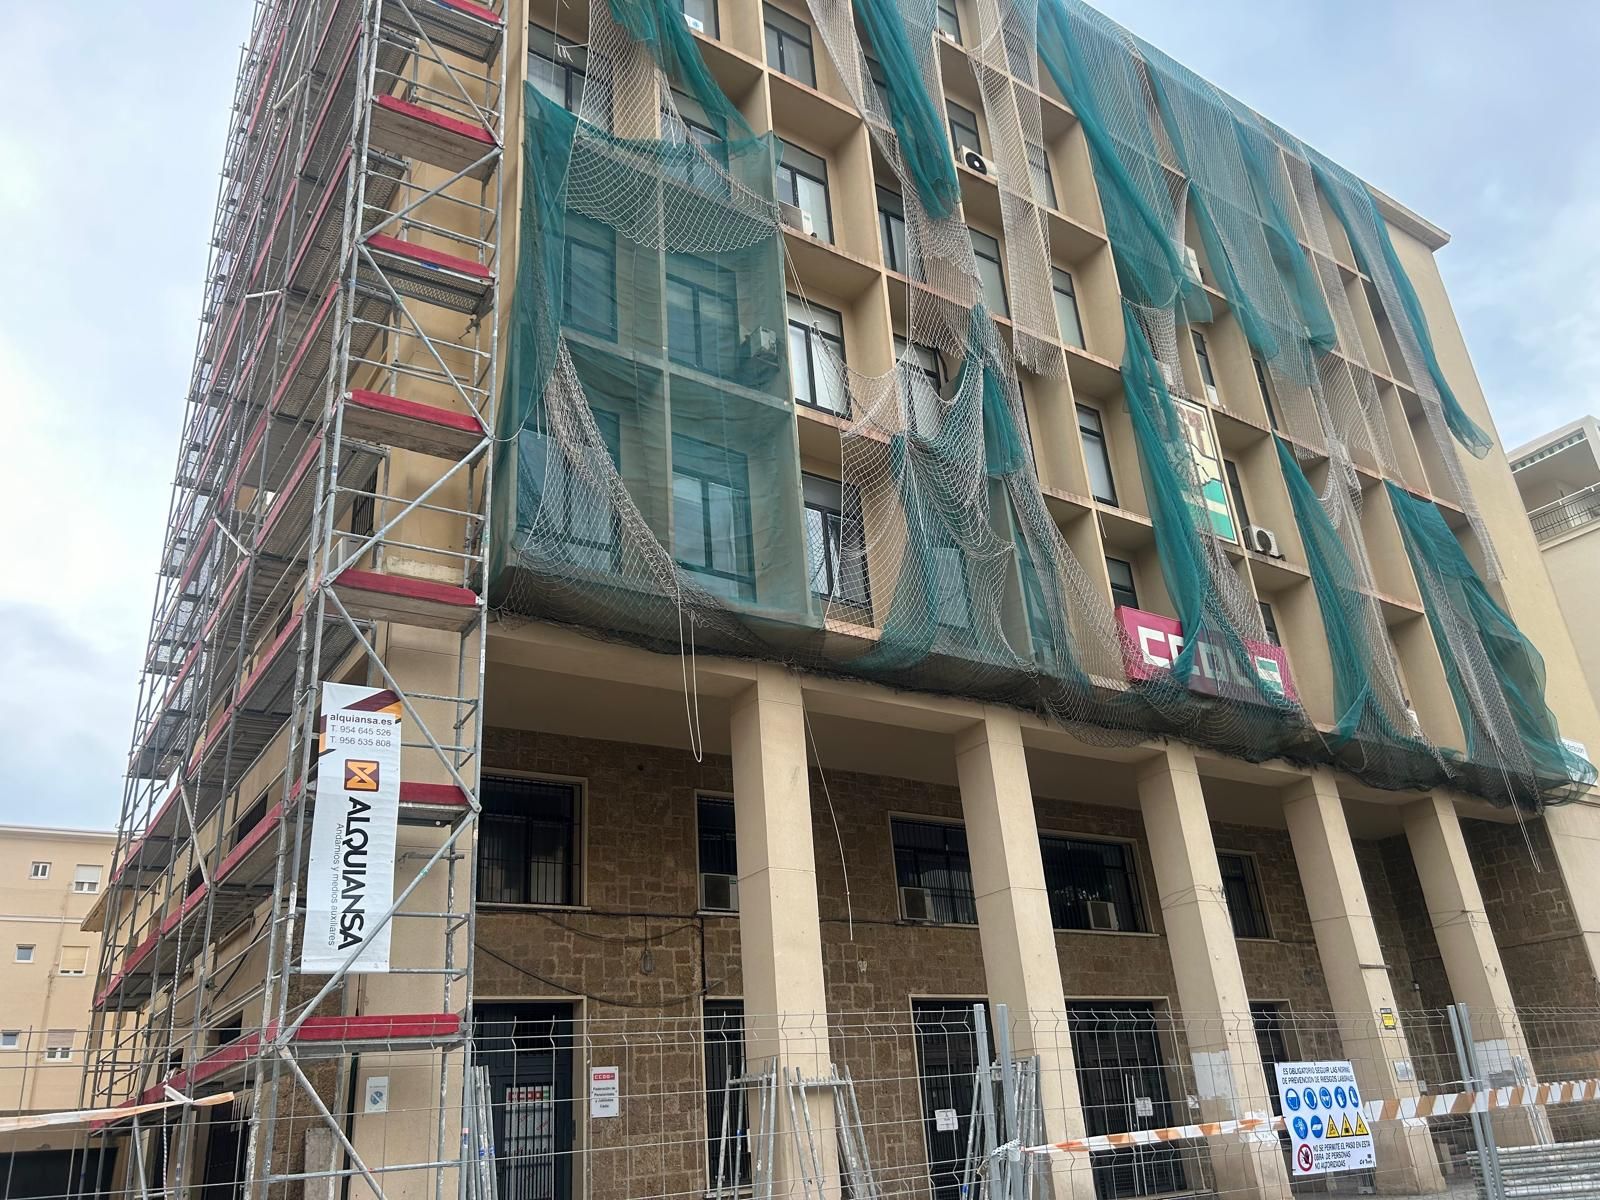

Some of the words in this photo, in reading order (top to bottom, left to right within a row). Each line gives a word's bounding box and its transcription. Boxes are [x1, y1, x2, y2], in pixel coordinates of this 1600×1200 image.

[330, 714, 392, 726] alquiansa.es
[330, 725, 337, 733] T.
[340, 725, 356, 734] 954
[358, 727, 374, 736] 645
[376, 728, 392, 737] 526
[330, 736, 337, 744] T.
[340, 736, 355, 745] 956
[358, 738, 373, 747] 535
[376, 739, 391, 747] 808
[333, 823, 344, 864] Andamios
[338, 796, 371, 950] ALQUIANSA
[331, 874, 340, 903] medios
[328, 906, 338, 946] auxiliares
